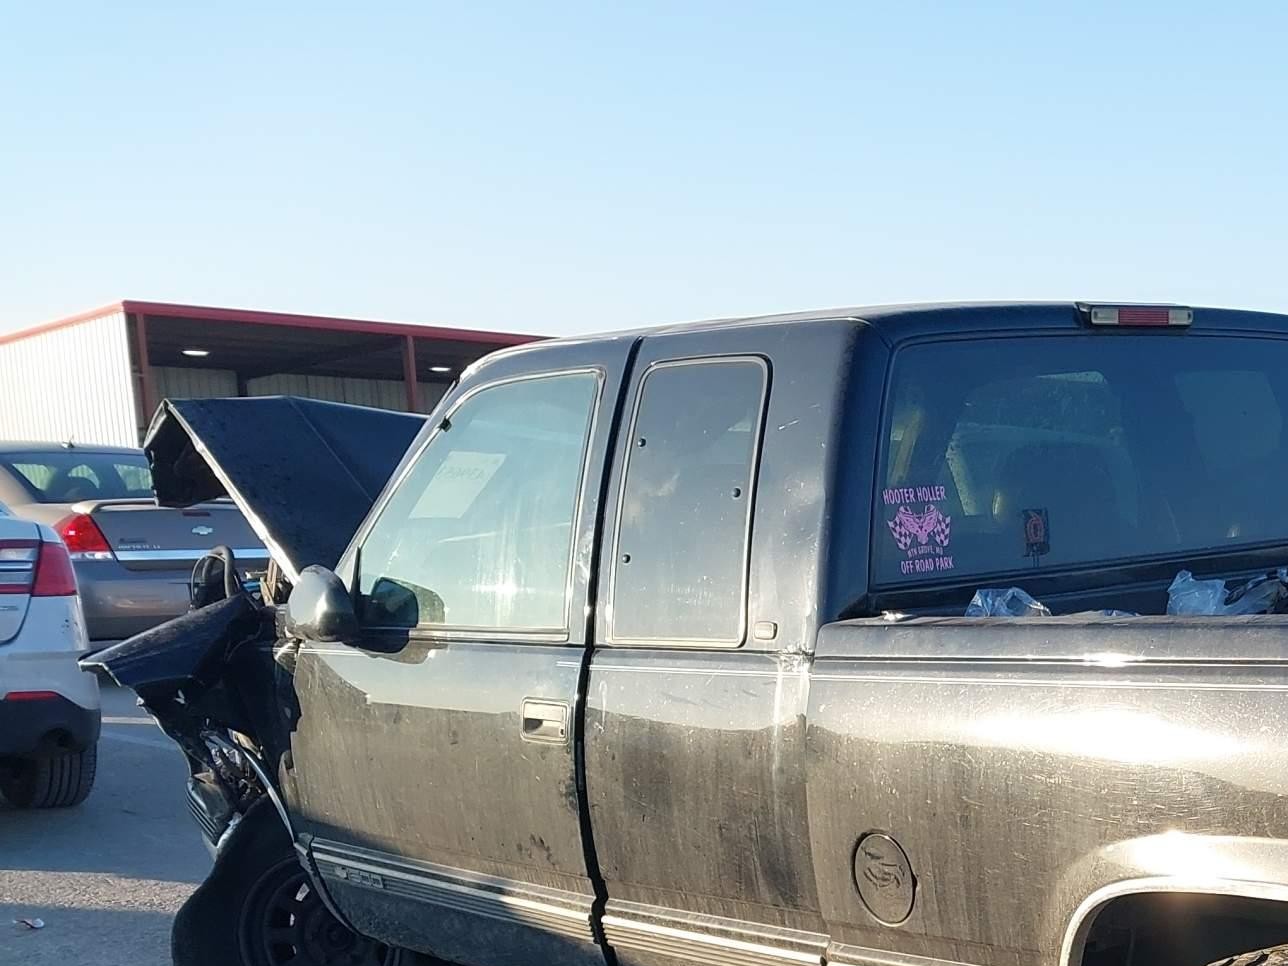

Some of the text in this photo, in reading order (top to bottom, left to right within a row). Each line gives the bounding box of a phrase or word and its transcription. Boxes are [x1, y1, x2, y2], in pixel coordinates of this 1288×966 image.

[882, 486, 946, 505] HOOTER HOLLER
[900, 556, 955, 575] OFF ROAD PARK
